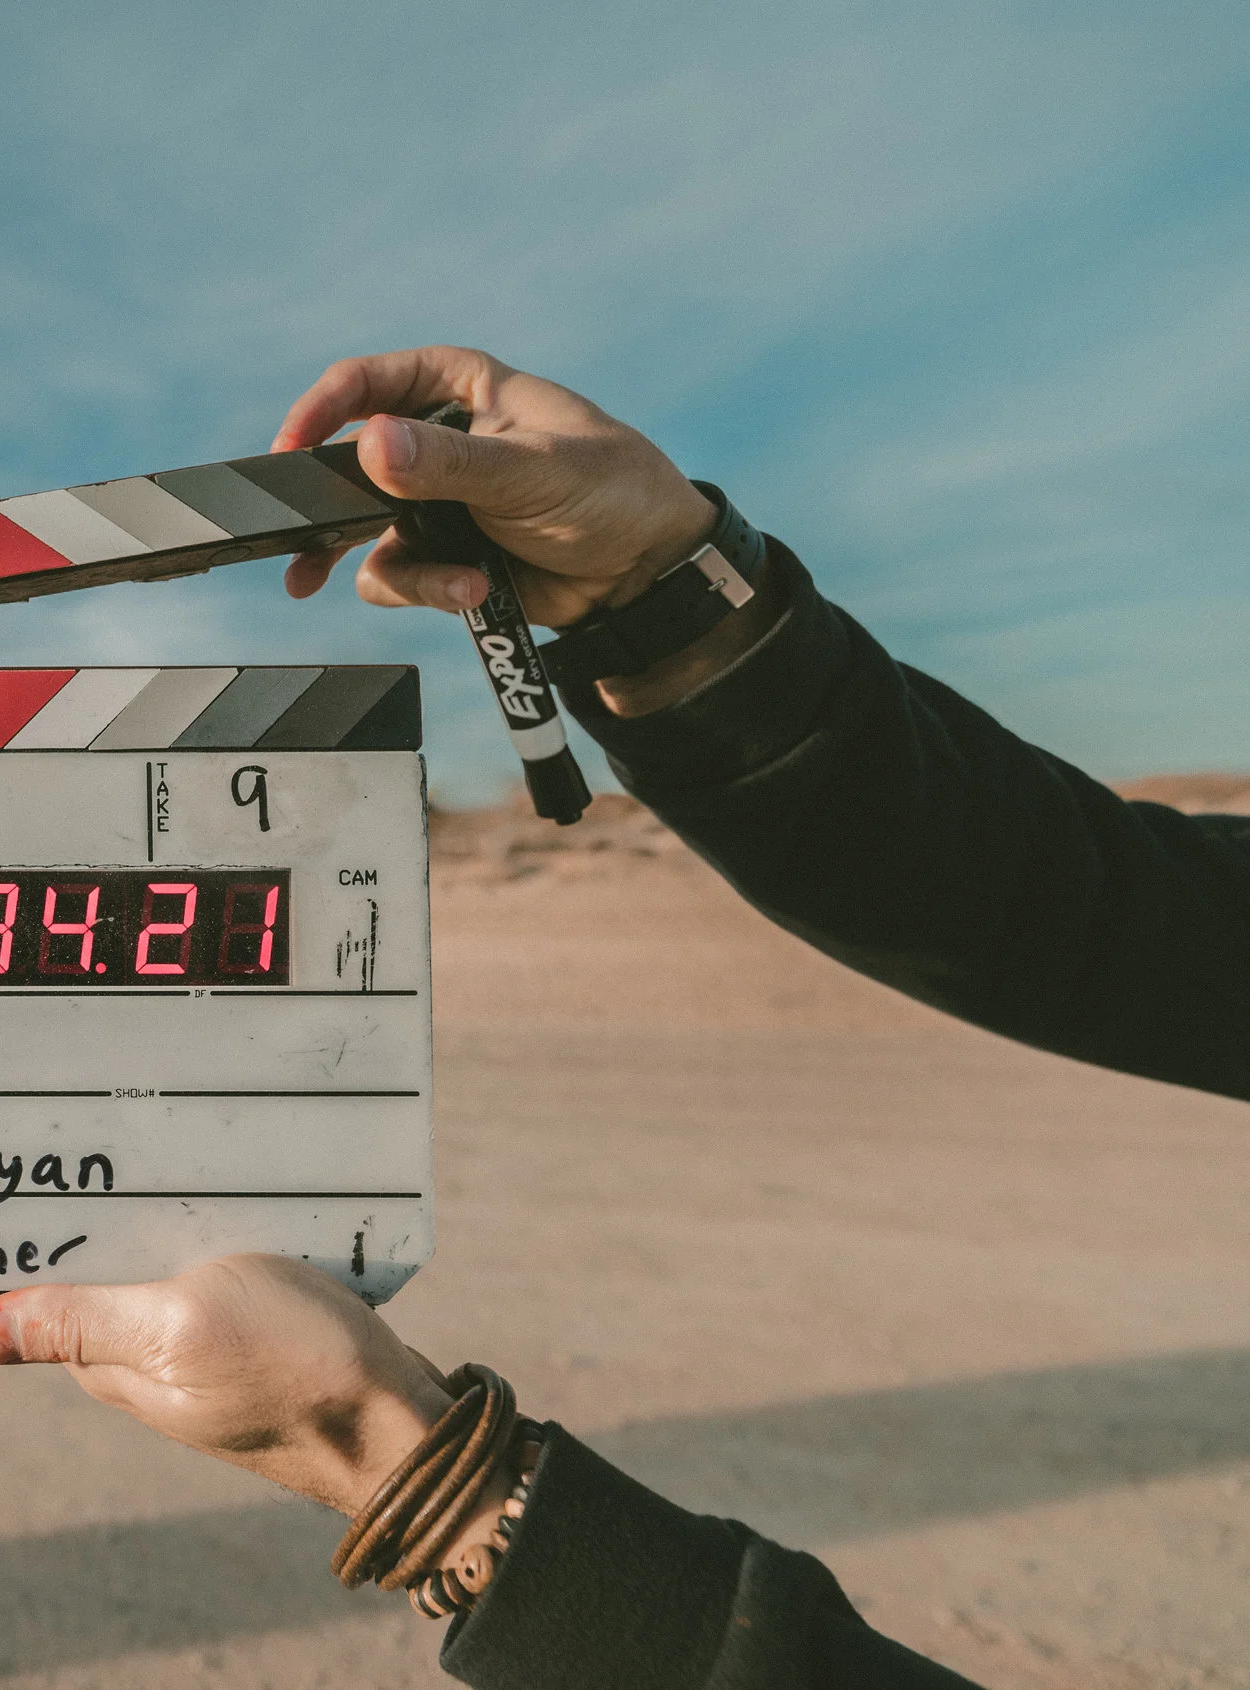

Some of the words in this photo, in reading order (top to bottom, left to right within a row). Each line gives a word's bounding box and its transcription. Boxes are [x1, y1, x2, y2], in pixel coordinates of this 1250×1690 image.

[515, 623, 533, 658] erase
[480, 635, 544, 719] EXPO
[529, 658, 541, 680] dry
[157, 763, 169, 832] TAKE
[231, 766, 270, 832] 9
[339, 870, 377, 885] CAM
[195, 990, 206, 998] DF
[116, 1089, 154, 1098] SHOW#
